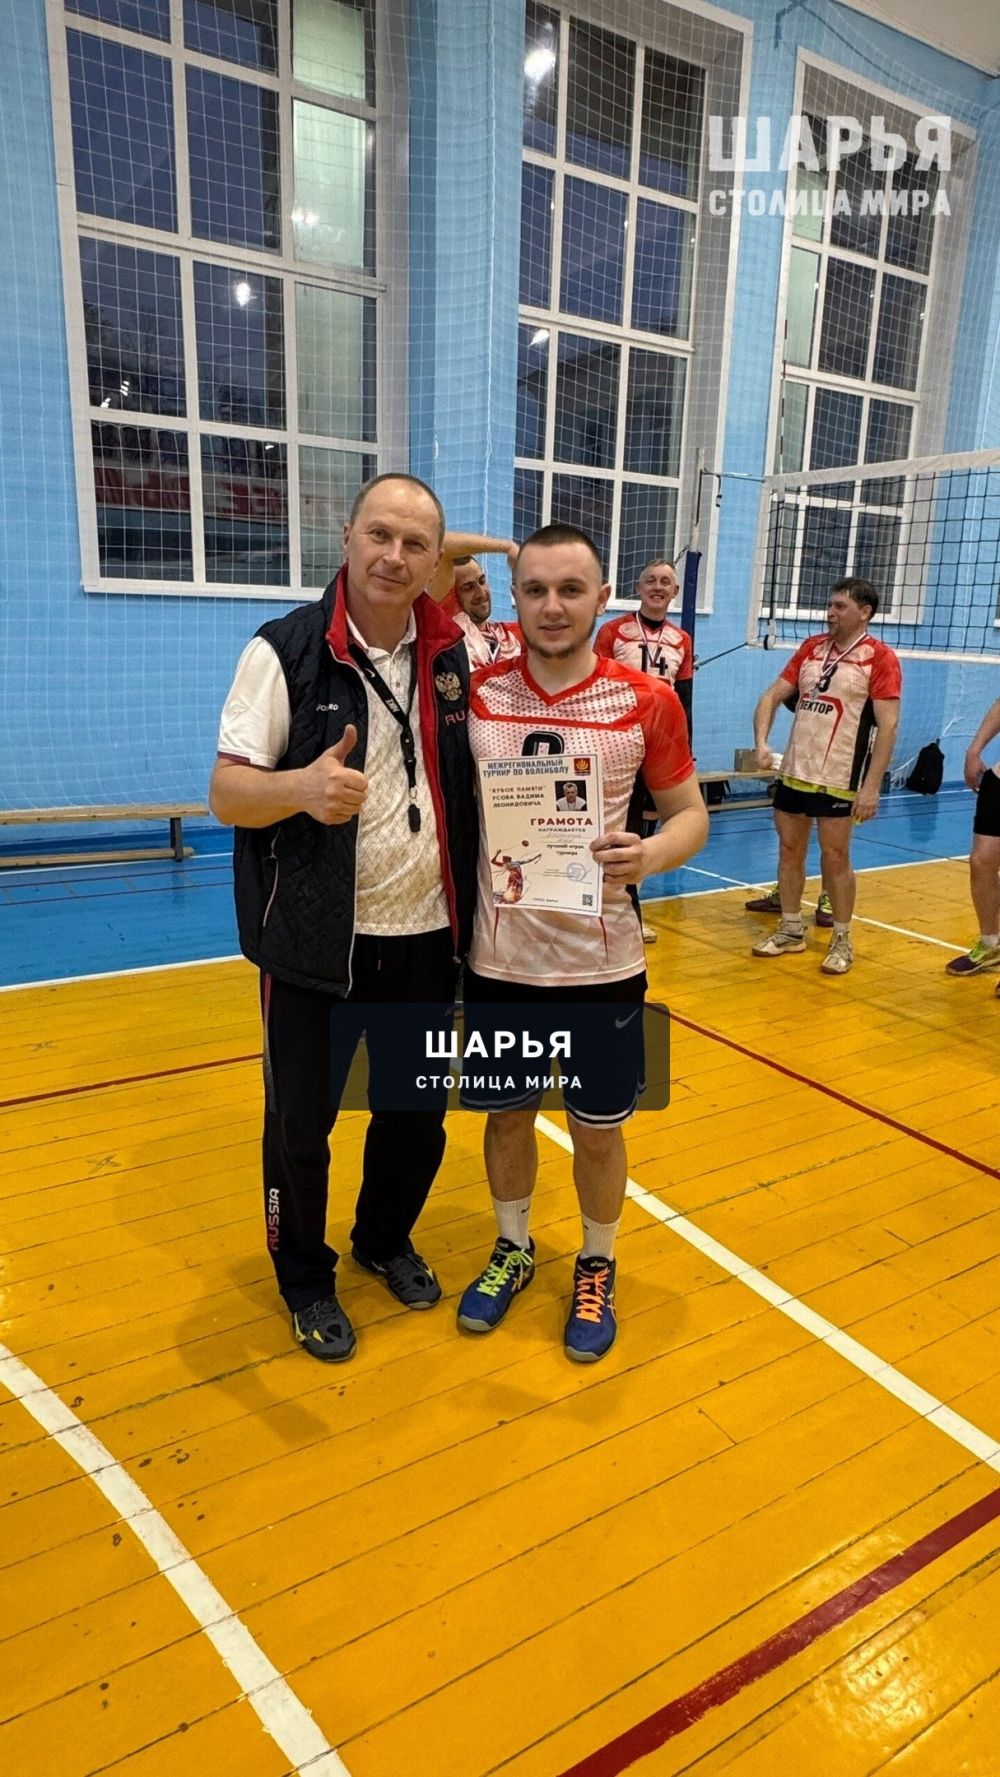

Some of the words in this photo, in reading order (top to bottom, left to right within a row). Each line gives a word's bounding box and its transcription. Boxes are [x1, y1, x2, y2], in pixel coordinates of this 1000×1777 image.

[487, 759, 564, 770] МЕЖРЕГИОНАЛЬНЫЙ
[483, 769, 511, 778] ТУРНИР
[513, 768, 523, 776] ПО
[525, 766, 569, 775] ВОЛЕЙБОЛУ
[530, 817, 593, 826] ГРАМОТА
[267, 1187, 280, 1252] RUSSIA
